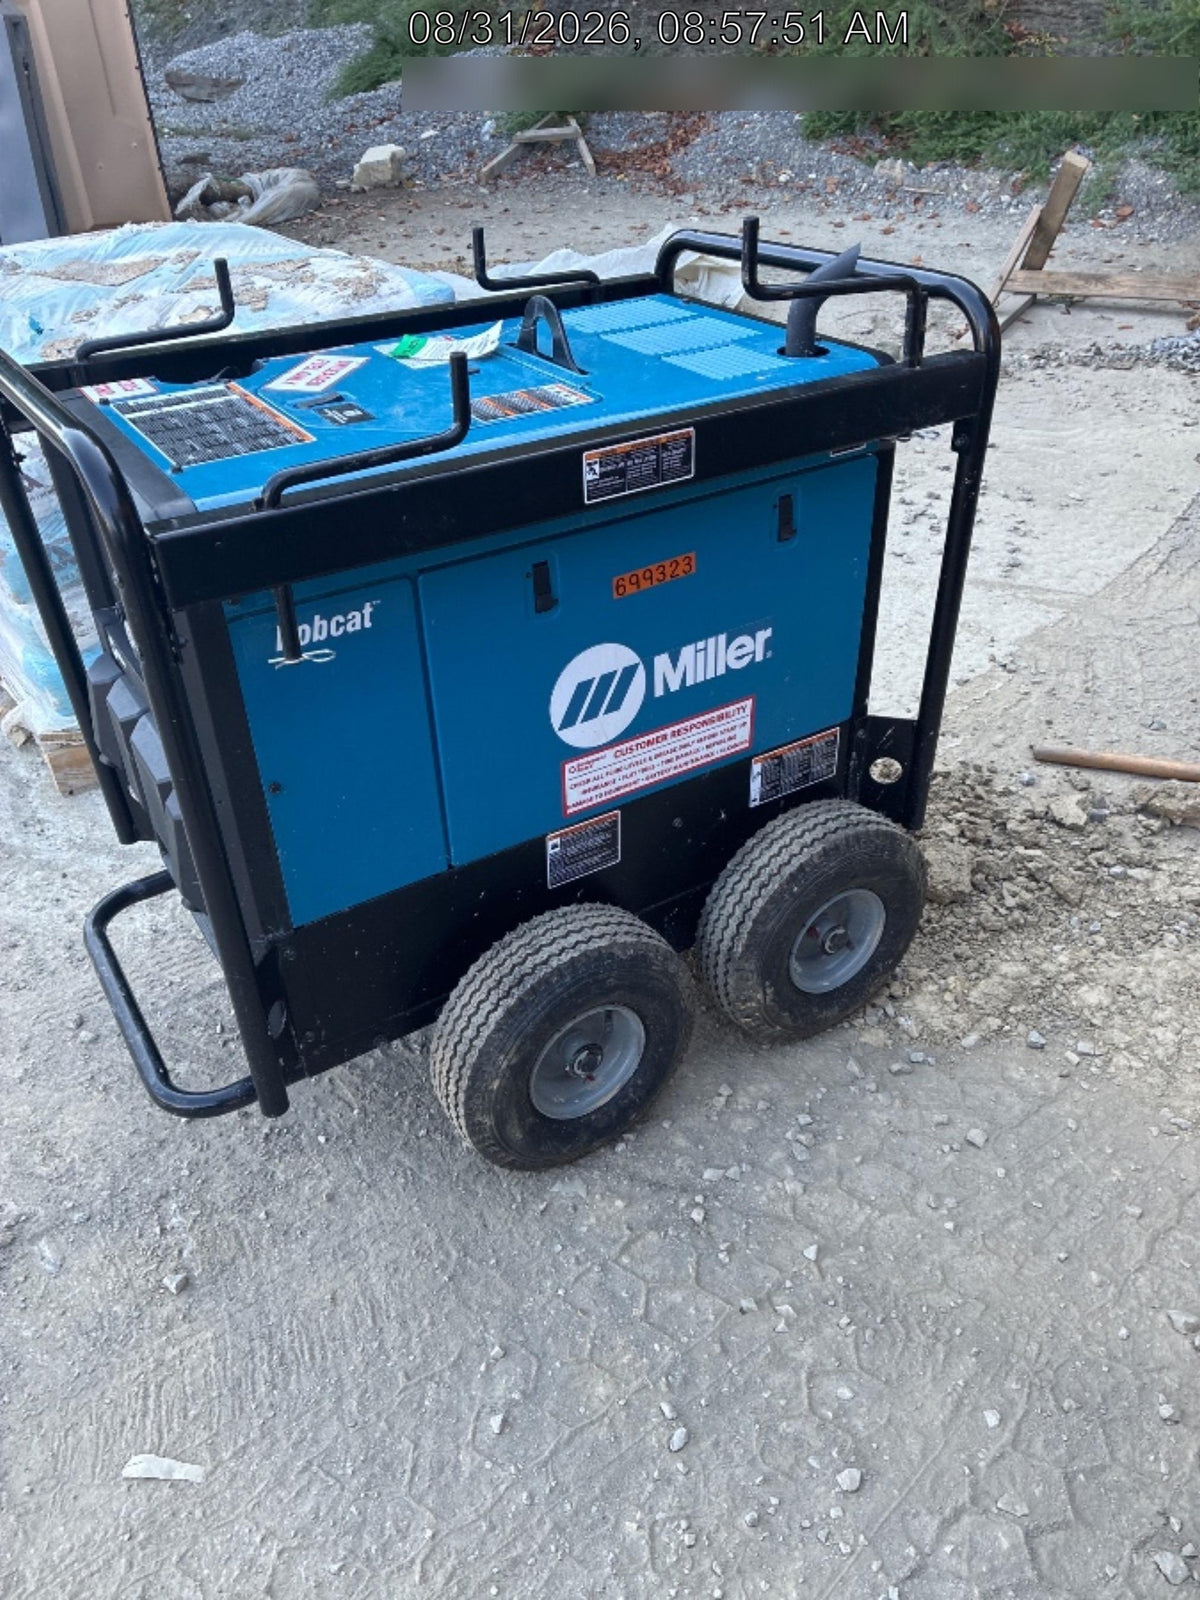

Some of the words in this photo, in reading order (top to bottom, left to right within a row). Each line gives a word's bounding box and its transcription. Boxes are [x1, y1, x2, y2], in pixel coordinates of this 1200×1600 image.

[615, 556, 693, 596] 699323
[276, 602, 374, 651] obcat
[654, 627, 773, 697] Miller
[613, 732, 668, 759] CUSTOMER
[670, 704, 748, 739] RESPONSIBILITY
